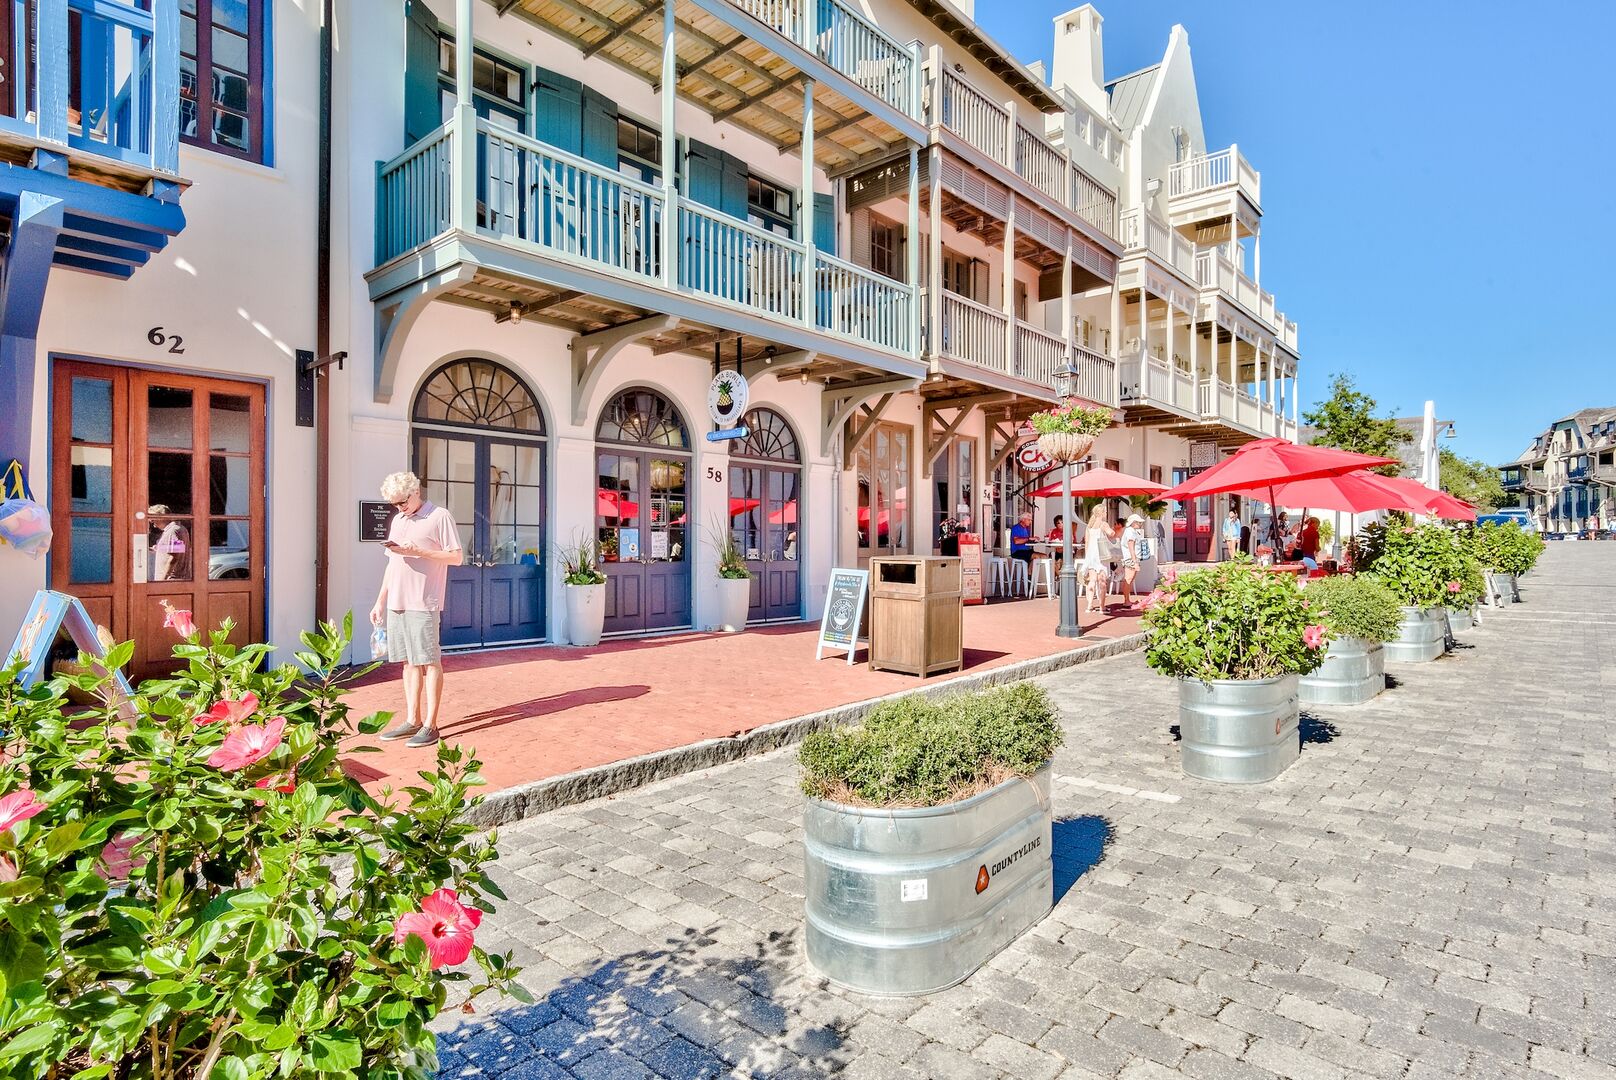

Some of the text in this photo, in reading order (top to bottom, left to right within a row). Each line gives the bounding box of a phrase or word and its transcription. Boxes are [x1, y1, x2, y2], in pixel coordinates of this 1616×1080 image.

[148, 327, 185, 354] 62
[711, 371, 741, 391] PLAYA BOWLS
[707, 467, 722, 483] 58
[1022, 463, 1050, 472] KITCHEN
[983, 489, 991, 501] 54
[991, 836, 1041, 877] COUNTYLINE
